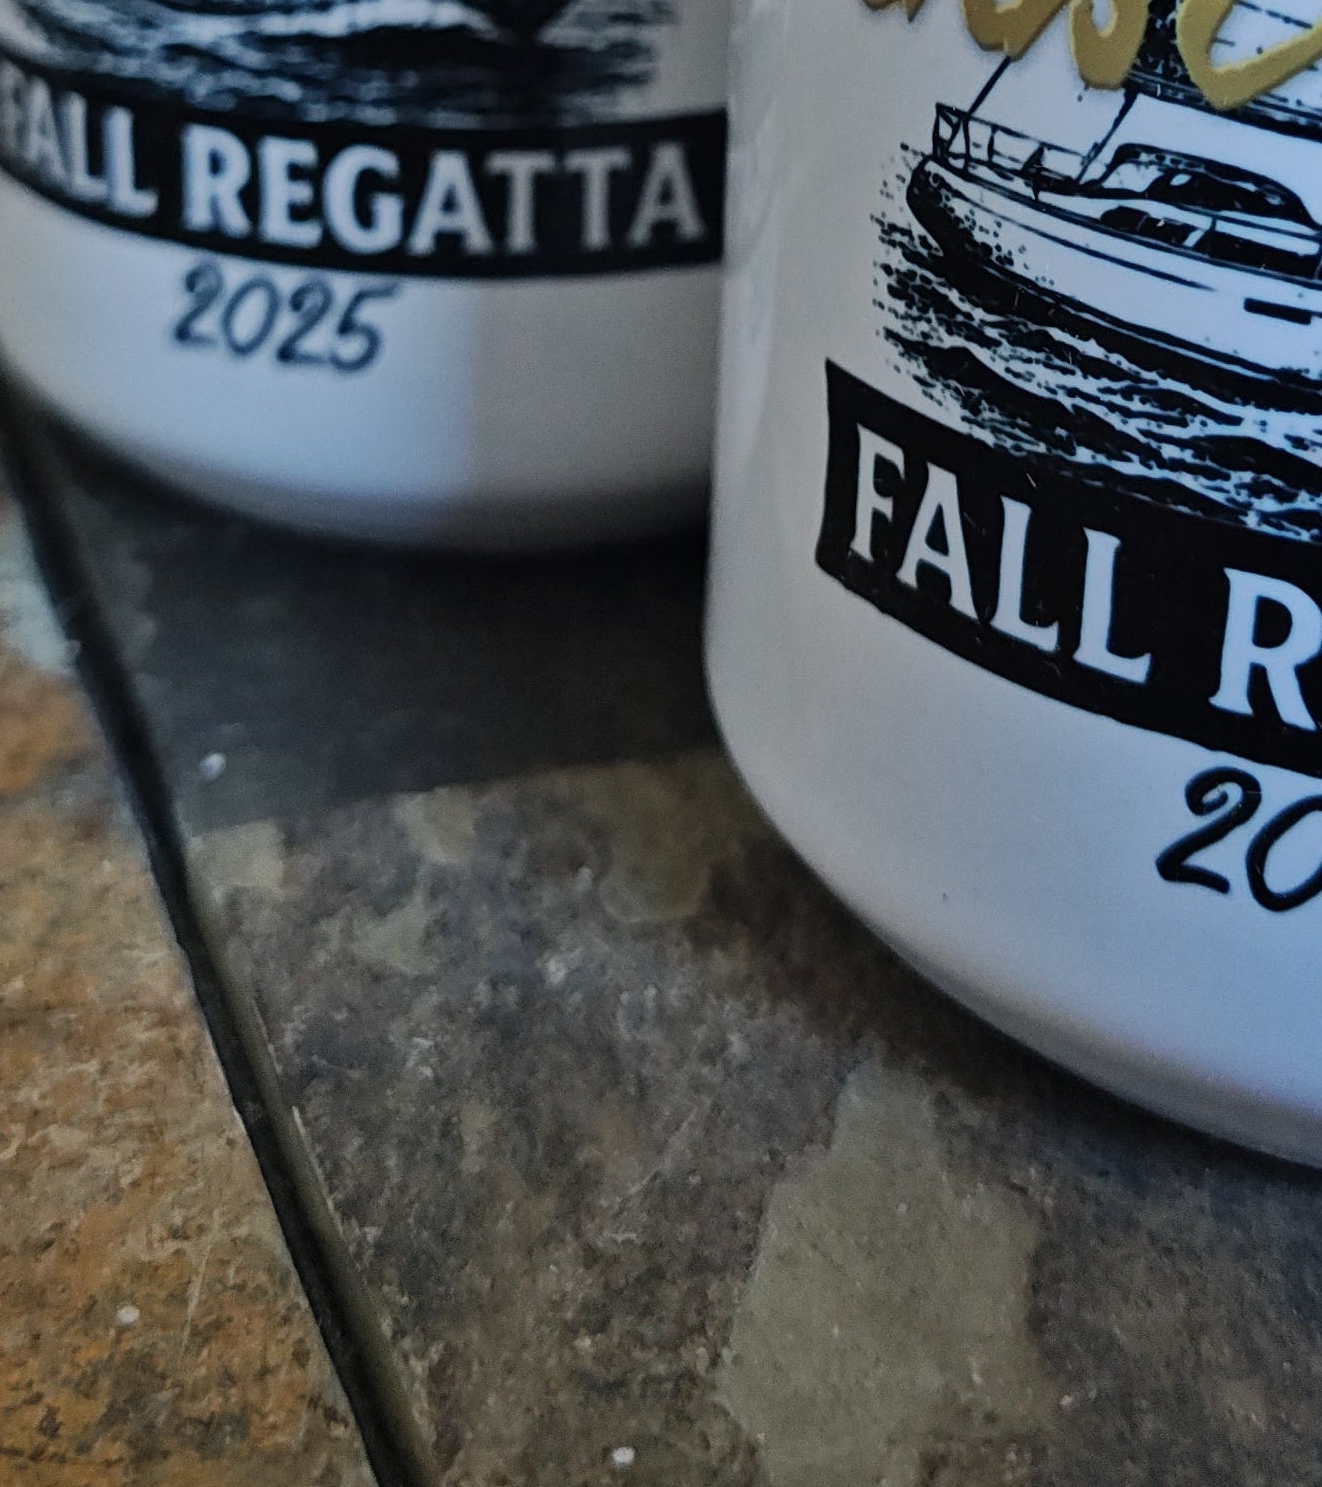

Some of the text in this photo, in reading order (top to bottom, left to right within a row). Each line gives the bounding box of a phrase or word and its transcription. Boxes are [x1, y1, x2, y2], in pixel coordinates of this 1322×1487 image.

[180, 121, 706, 259] REGATTA
[173, 258, 404, 375] 2025
[848, 421, 1152, 681] FALL
